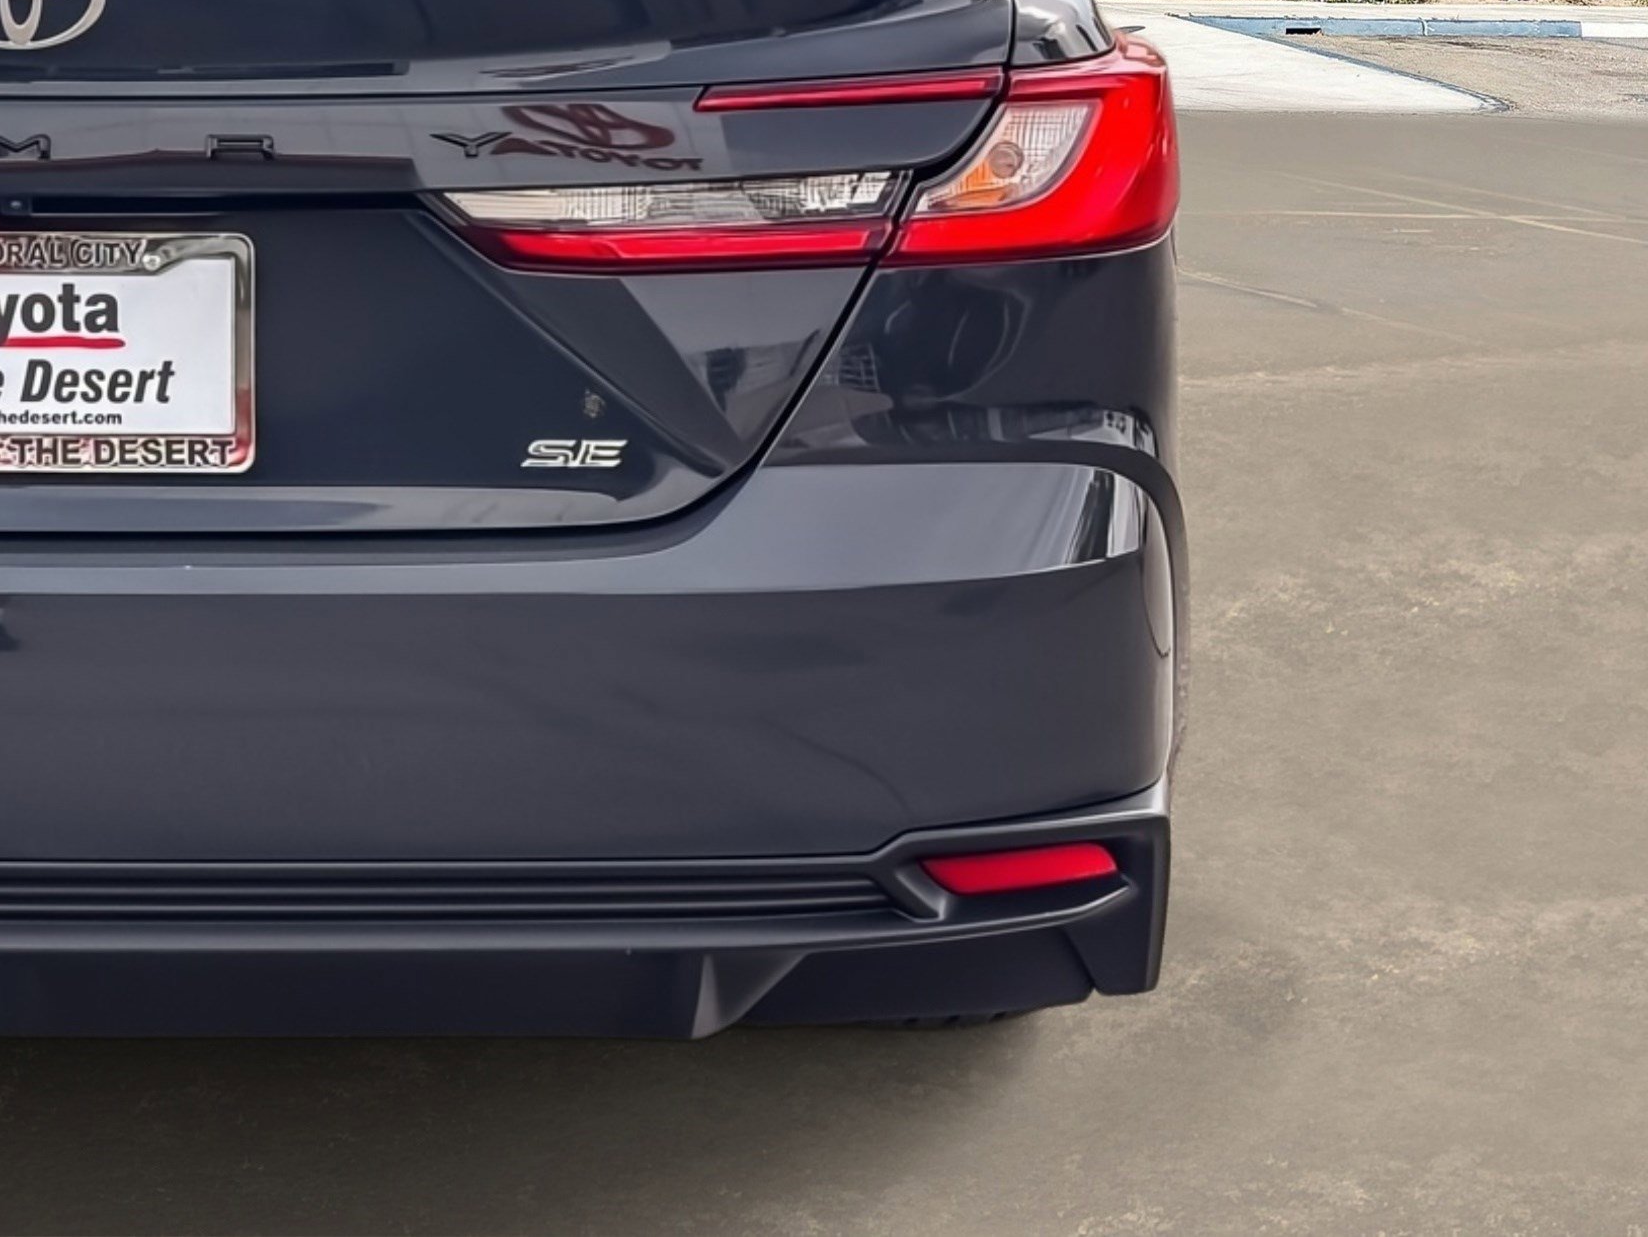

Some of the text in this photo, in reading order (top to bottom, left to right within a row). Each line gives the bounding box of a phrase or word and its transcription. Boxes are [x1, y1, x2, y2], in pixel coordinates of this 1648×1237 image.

[71, 241, 145, 267] CITY
[20, 359, 175, 403] Desert
[12, 436, 85, 466] THE
[93, 437, 235, 467] DESERT
